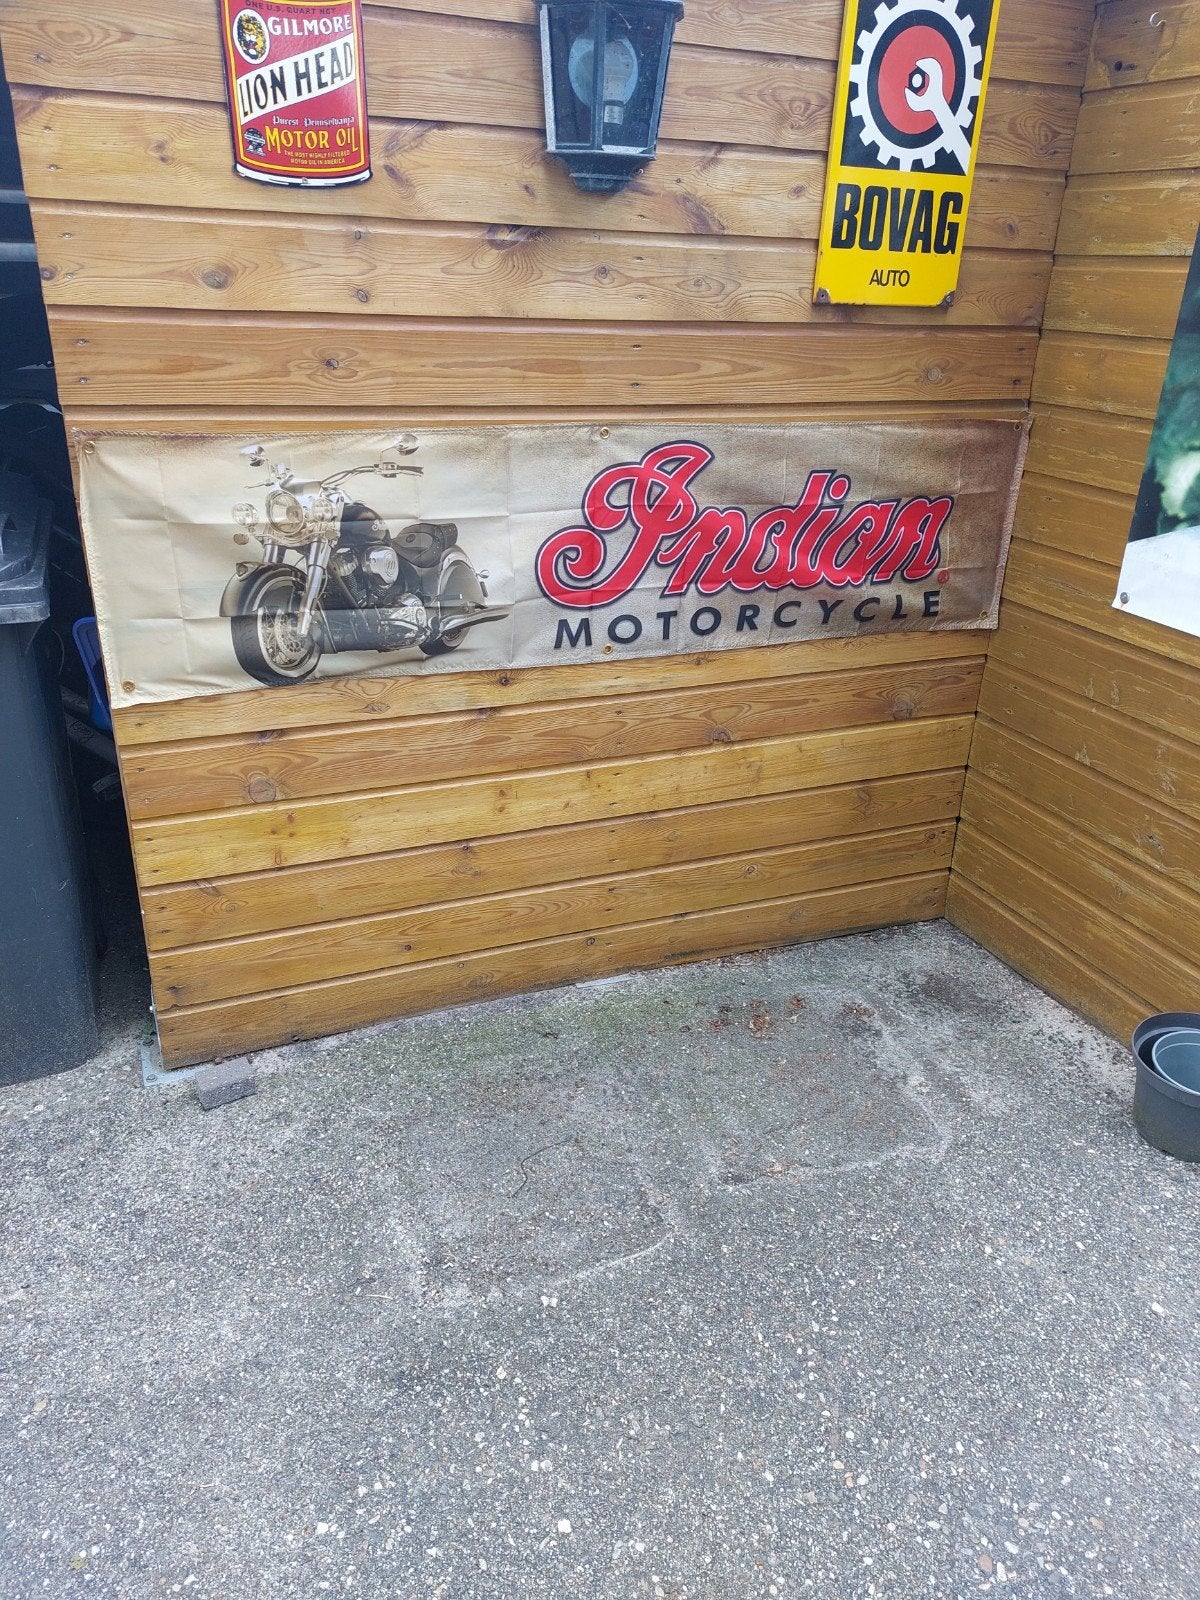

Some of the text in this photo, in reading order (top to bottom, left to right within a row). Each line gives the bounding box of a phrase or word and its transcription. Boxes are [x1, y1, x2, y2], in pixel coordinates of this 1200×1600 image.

[245, 0, 264, 10] ONE
[286, 7, 317, 15] QUART
[267, 14, 353, 36] GILMORE
[239, 41, 354, 118] LION HEAD
[272, 115, 299, 127] Purest
[265, 125, 359, 154] MOTOR OIL
[324, 157, 346, 165] AMERICA
[830, 182, 964, 255] BOVAG
[869, 269, 911, 287] AUTO
[534, 439, 955, 611] Indian
[553, 589, 942, 650] MOTORCYCLE
